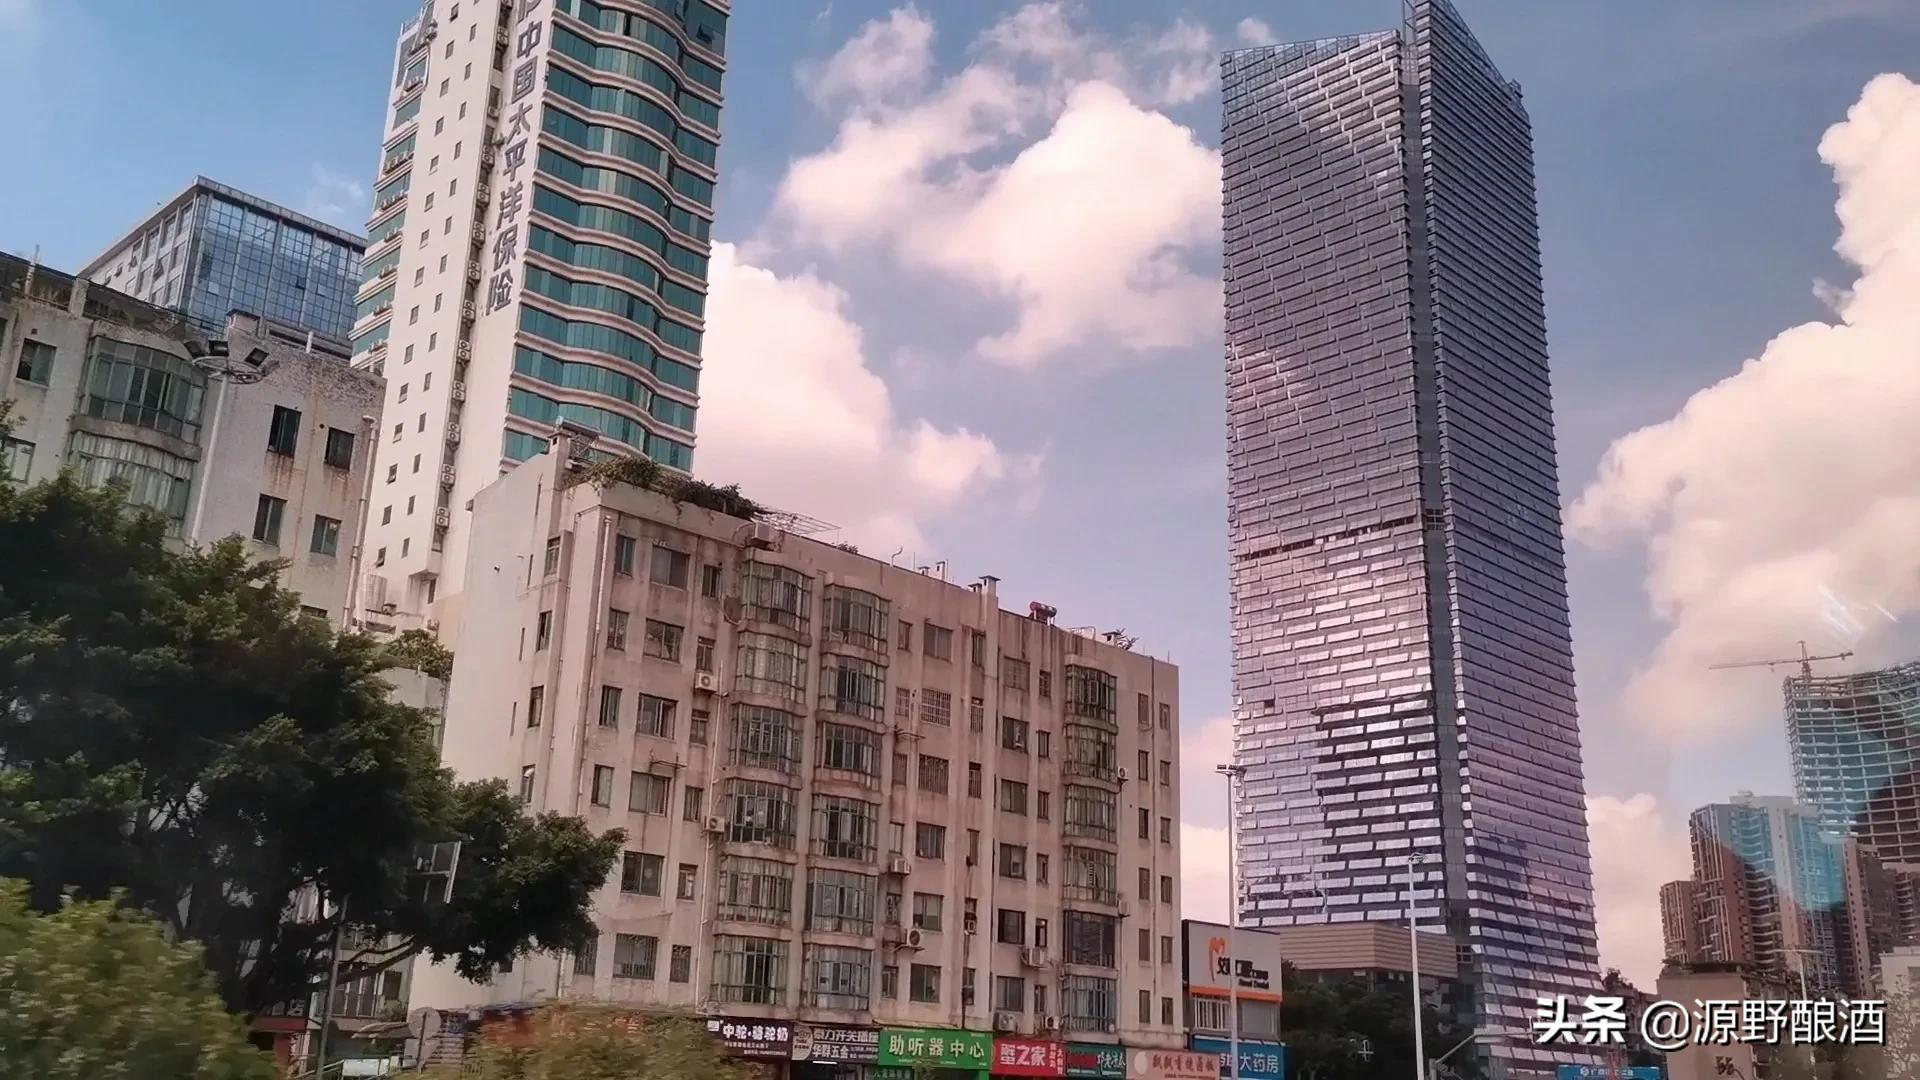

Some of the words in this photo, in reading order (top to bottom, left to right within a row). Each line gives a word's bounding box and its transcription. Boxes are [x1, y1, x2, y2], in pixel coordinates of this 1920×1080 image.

[485, 20, 543, 316] 中国太平洋保险
[888, 1035, 985, 1058] 助听器中心
